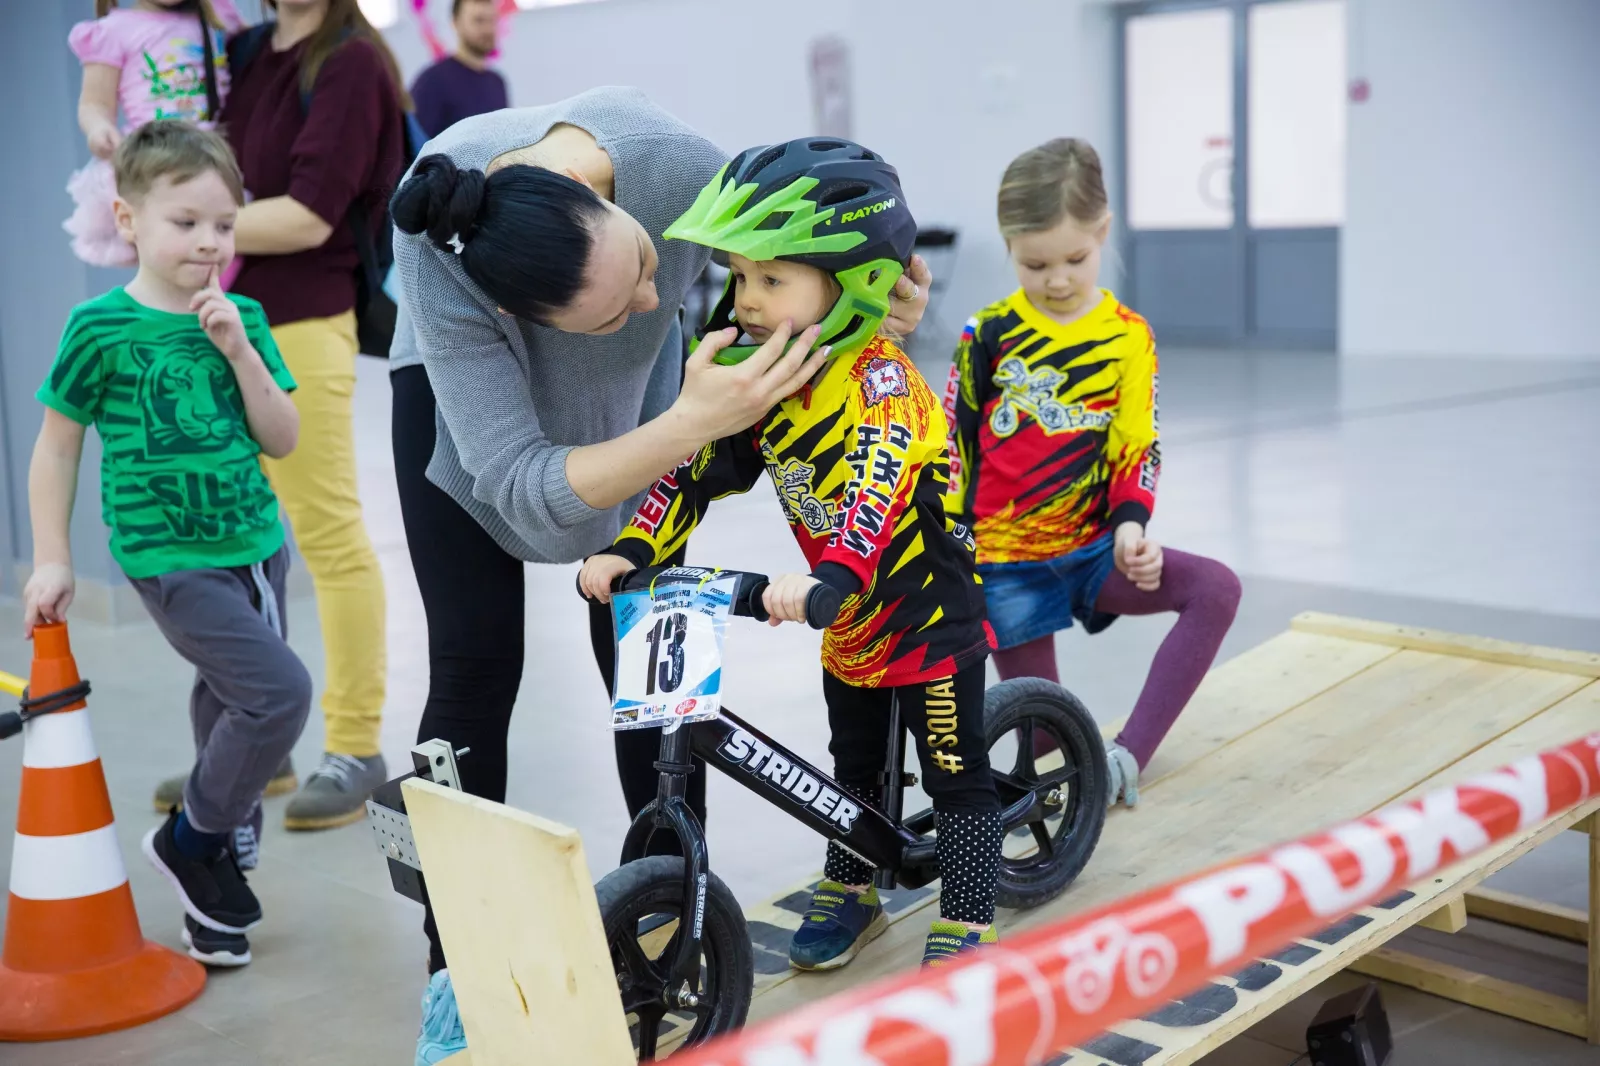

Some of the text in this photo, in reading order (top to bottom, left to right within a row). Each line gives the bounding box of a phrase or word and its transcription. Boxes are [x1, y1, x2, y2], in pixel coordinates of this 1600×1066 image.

[841, 198, 896, 223] RATONI
[646, 613, 688, 696] 13
[719, 728, 861, 834] STRIDER
[1173, 754, 1549, 969] PUKY
[693, 885, 707, 941] STRIDER
